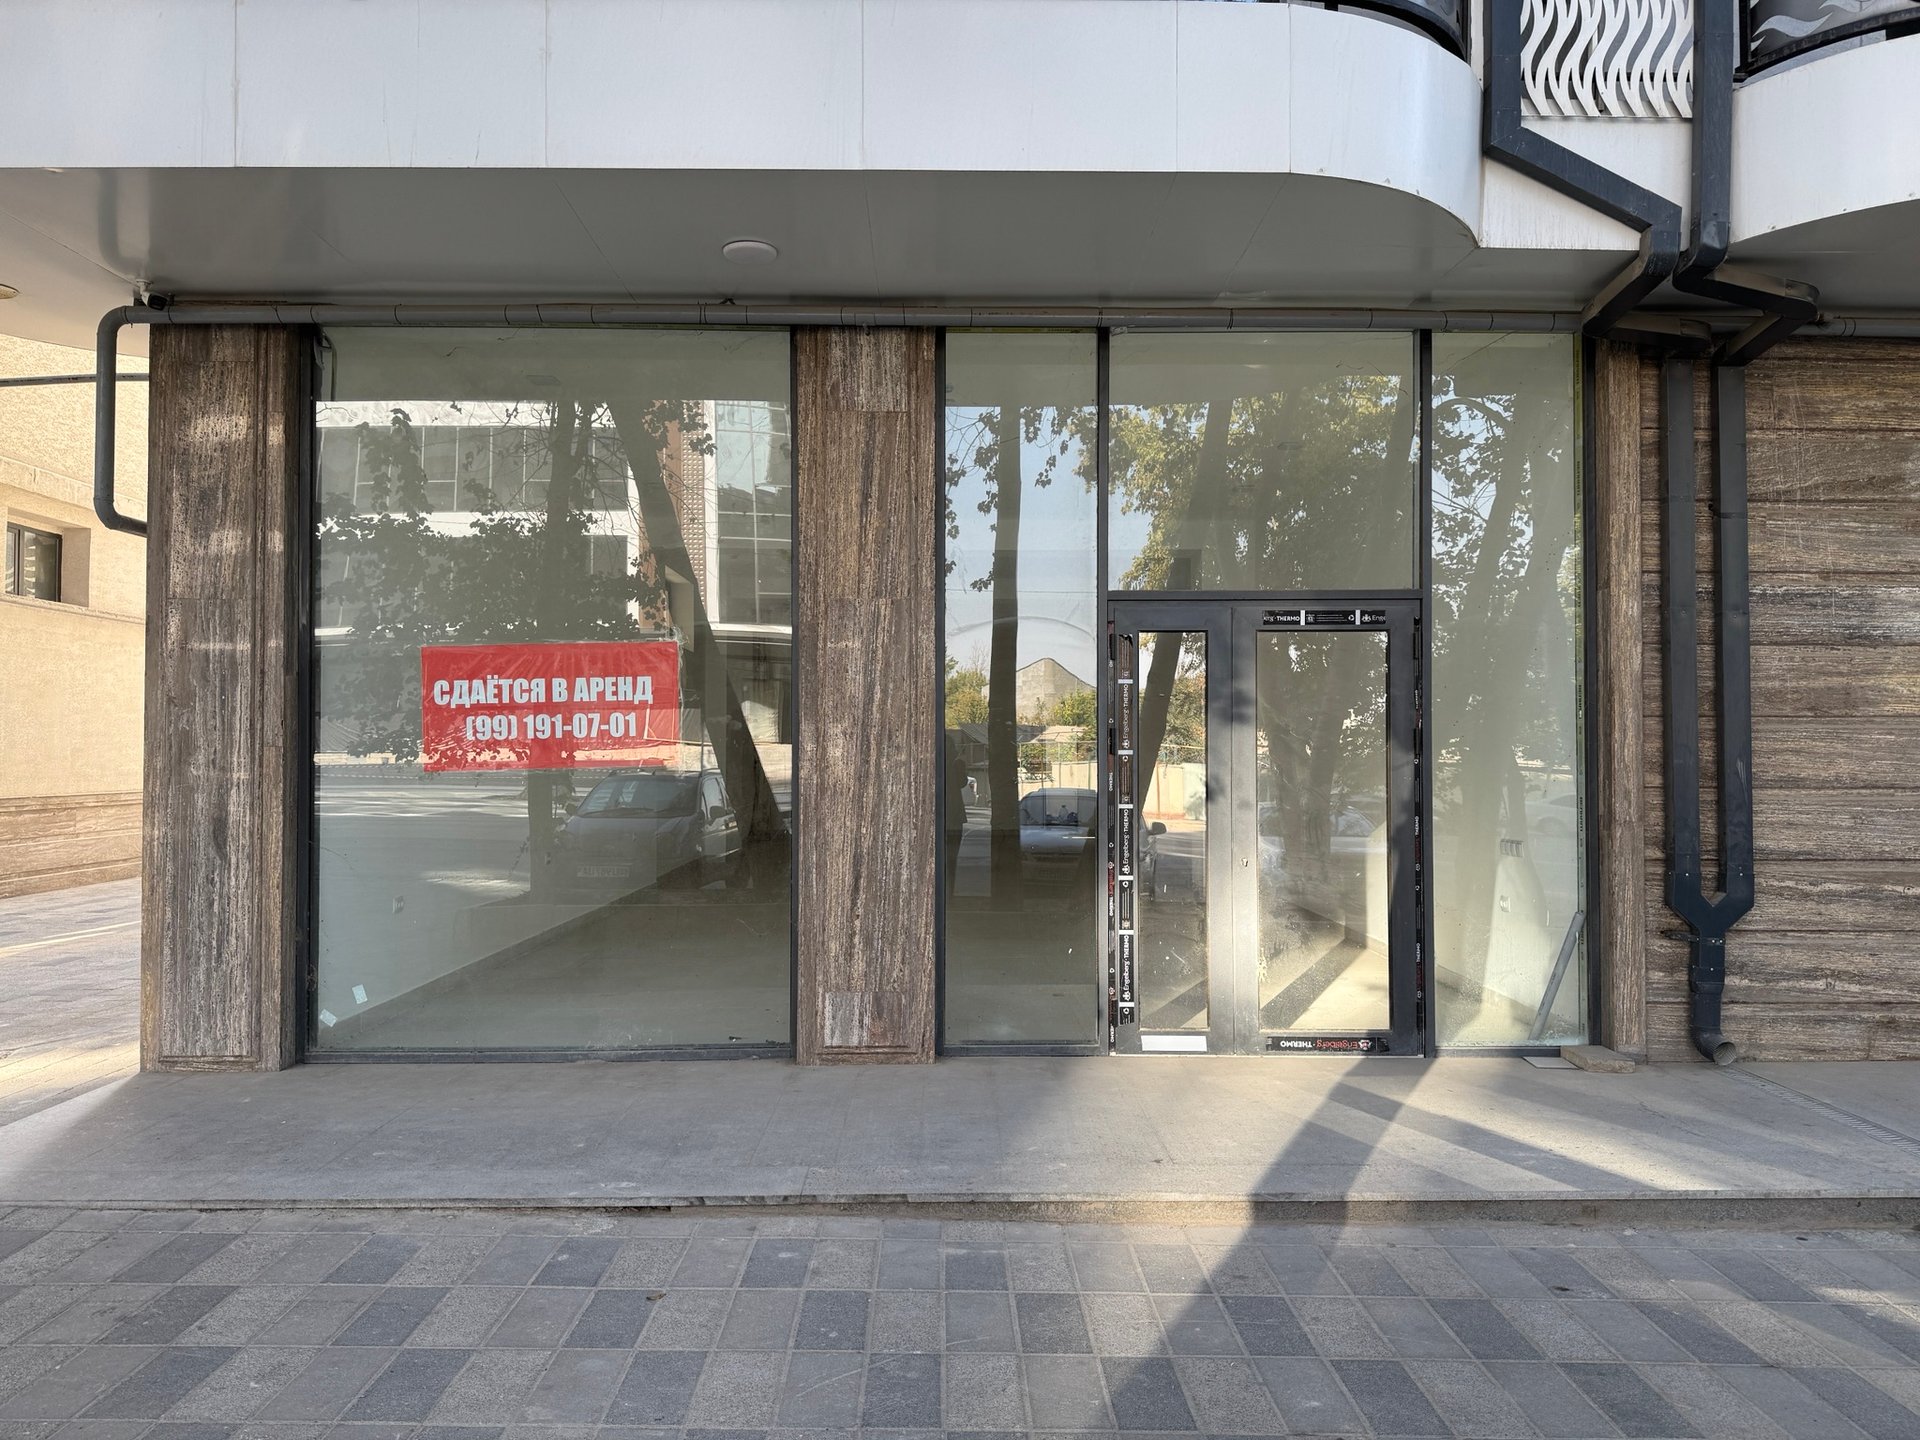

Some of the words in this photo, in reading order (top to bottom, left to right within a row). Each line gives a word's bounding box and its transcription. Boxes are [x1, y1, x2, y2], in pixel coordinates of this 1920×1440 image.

[434, 675, 545, 708] СДАЁТСЯ
[552, 678, 567, 702] В
[574, 676, 653, 704] АРЕНД
[466, 714, 518, 740] (99)
[523, 712, 636, 739] 191-07-01
[1280, 1040, 1312, 1048] THERMO
